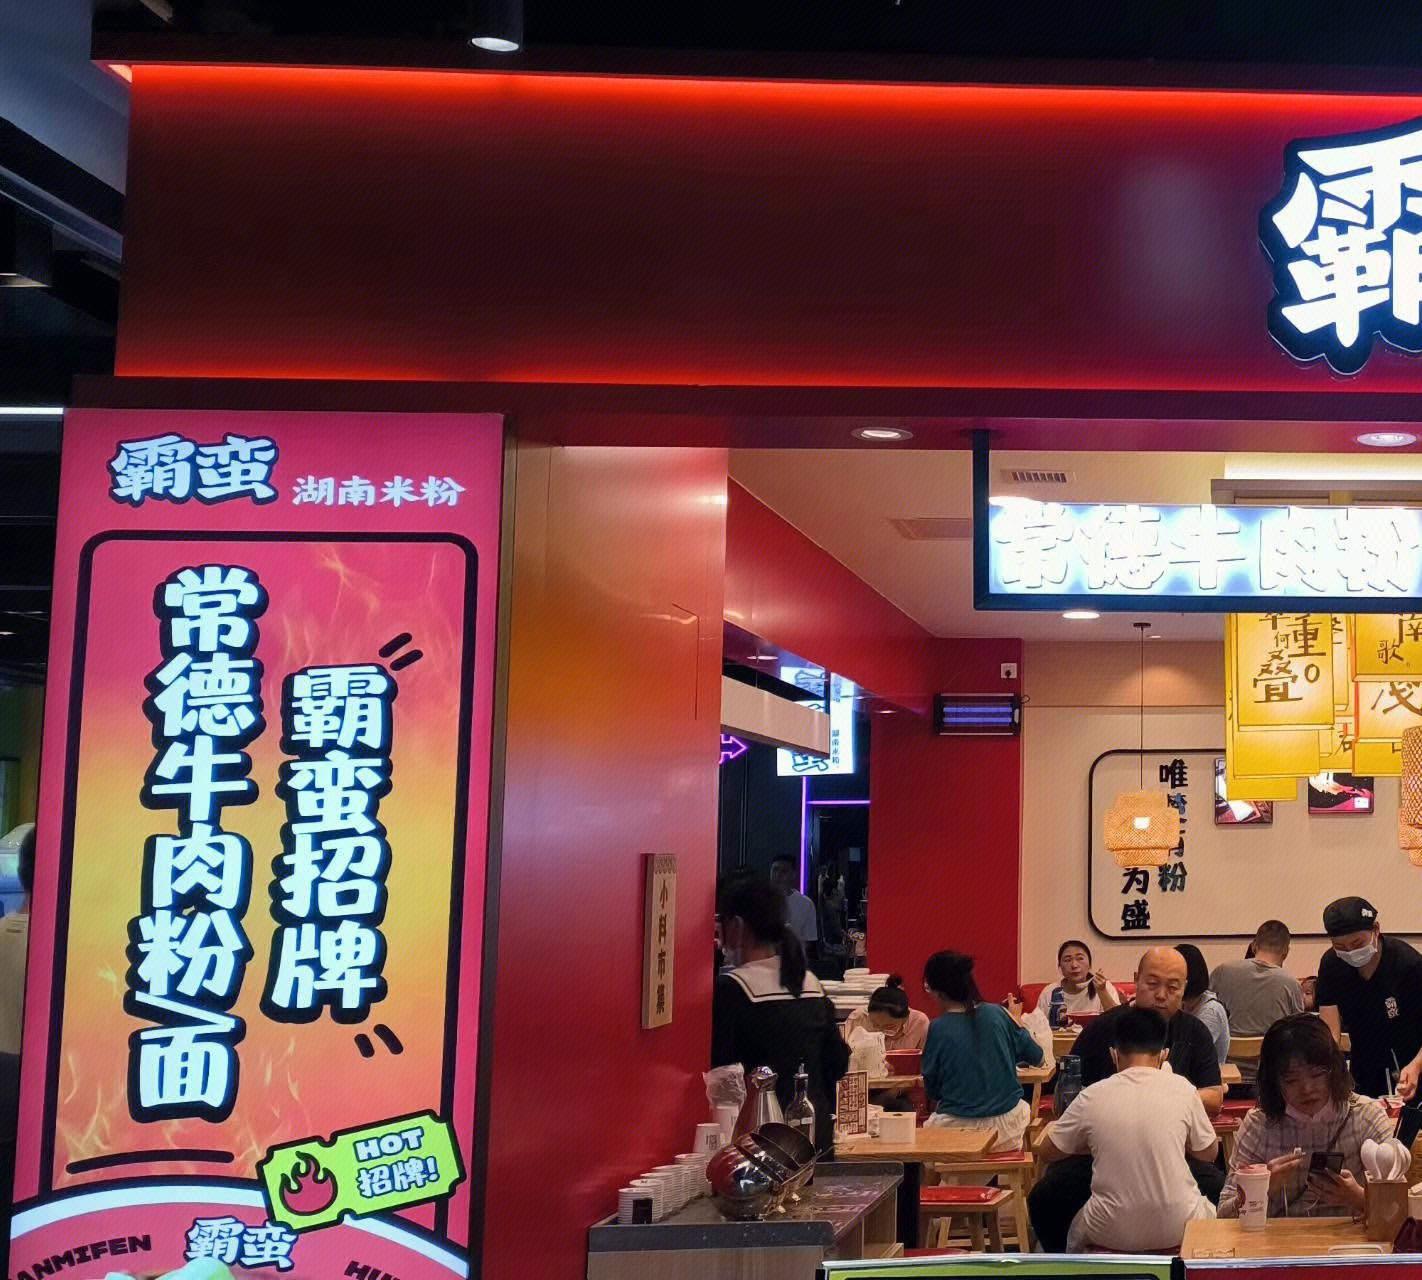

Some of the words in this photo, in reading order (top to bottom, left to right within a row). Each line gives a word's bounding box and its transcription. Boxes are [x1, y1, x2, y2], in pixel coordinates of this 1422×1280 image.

[112, 436, 277, 502] 霸蛮
[291, 474, 466, 509] 湖南米粉
[994, 502, 1421, 593] 常德牛肉粉
[271, 666, 390, 1010] 霸蛮招牌
[1159, 758, 1188, 893] 唯粉
[354, 1127, 425, 1162] HOT
[8, 1234, 152, 1280] ANMIFEN
[185, 1220, 297, 1270] 霸蛮
[344, 1260, 401, 1280] HU
